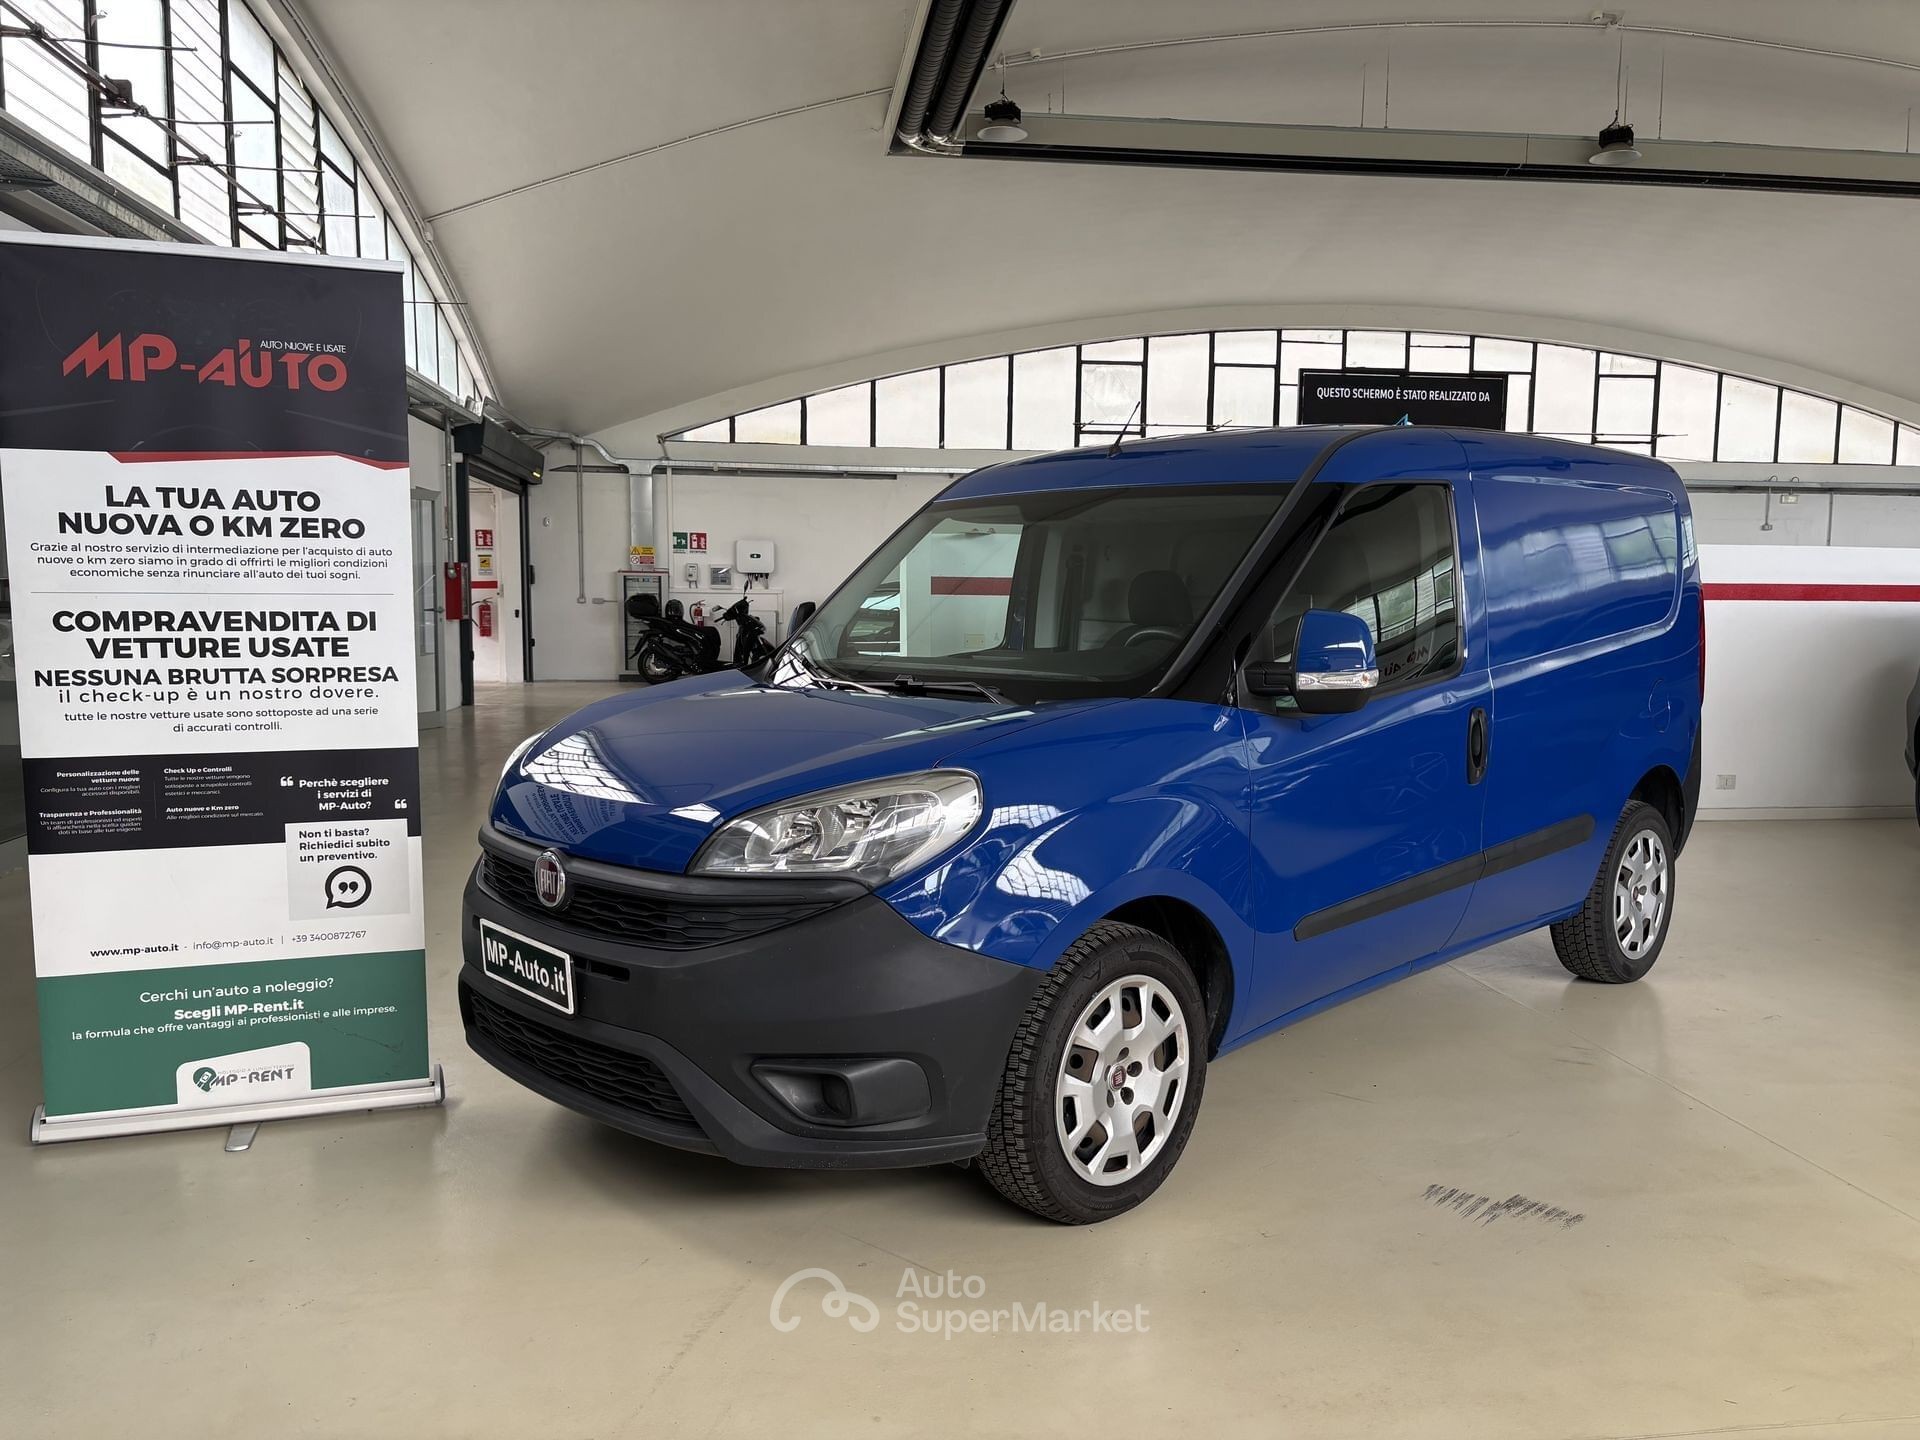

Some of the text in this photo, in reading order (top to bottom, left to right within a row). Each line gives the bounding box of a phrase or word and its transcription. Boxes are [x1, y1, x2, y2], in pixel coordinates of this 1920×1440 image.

[260, 340, 346, 353] AUTO NUOVE E USATE
[62, 331, 348, 392] MP-AUTO
[1316, 387, 1490, 401] QUESTO SCHERMO È STATO REALIZZATO DA
[105, 485, 320, 512] LA TUA AUTO
[58, 512, 365, 539] NUOVA O KM ZERO
[30, 542, 392, 557] Grazie al nostro servizio di intermediazione per l'acquisto di auto
[37, 556, 73, 564] nuove
[87, 555, 106, 564] km
[138, 556, 173, 565] siamo
[176, 556, 187, 565] in
[190, 557, 223, 567] grado
[226, 557, 237, 566] di
[239, 557, 274, 566] offrirti
[277, 558, 286, 566] le
[289, 558, 330, 569] migliori
[333, 558, 387, 568] condizioni
[70, 568, 144, 577] economiche
[183, 568, 240, 578] rinunciare
[243, 569, 284, 578] all'auto
[286, 570, 303, 578] dei
[306, 570, 327, 579] tuoi
[329, 570, 360, 581] sogni.
[52, 610, 376, 632] COMPRAVENDITA DI
[85, 637, 349, 659] VETTURE USATE
[34, 666, 399, 687] NESSUNA BRUTTA SORPRESA
[59, 685, 378, 704] il check-up è un nostro dovere.
[64, 712, 94, 721] tutte
[97, 711, 107, 720] le
[110, 711, 147, 720] nostre
[149, 711, 190, 719] vetture
[193, 710, 224, 718] usate
[255, 708, 313, 718] sottoposte
[315, 707, 328, 715] ad
[354, 706, 378, 715] serie
[173, 721, 282, 732] di accurati controlli.
[299, 776, 389, 788] Perchè scegliere
[317, 788, 371, 799] i servizi di
[89, 808, 142, 816] Professionalità
[319, 801, 371, 810] MP-Auto?
[299, 828, 369, 838] Non ti basta?
[299, 838, 390, 850] Richiedici subito
[317, 852, 377, 863] preventivo.
[539, 868, 557, 895] FIAT
[90, 930, 366, 957] www.mp-auto.it info@mp-auto.it +39 3400872767
[485, 936, 566, 996] MP-Auto.it
[140, 977, 333, 1002] Cerchi un'auto a noleggio?
[174, 998, 304, 1020] Scegli MP-Rent.it
[72, 1031, 82, 1040] la
[85, 1027, 130, 1039] formula
[133, 1025, 154, 1034] che
[157, 1023, 183, 1032] offre
[186, 1017, 234, 1030] vantaggi
[237, 1016, 246, 1025] ai
[250, 1011, 320, 1026] professionisti
[332, 1008, 350, 1017] alle
[353, 1006, 397, 1016] imprese.
[211, 1067, 295, 1087] MP-RENT
